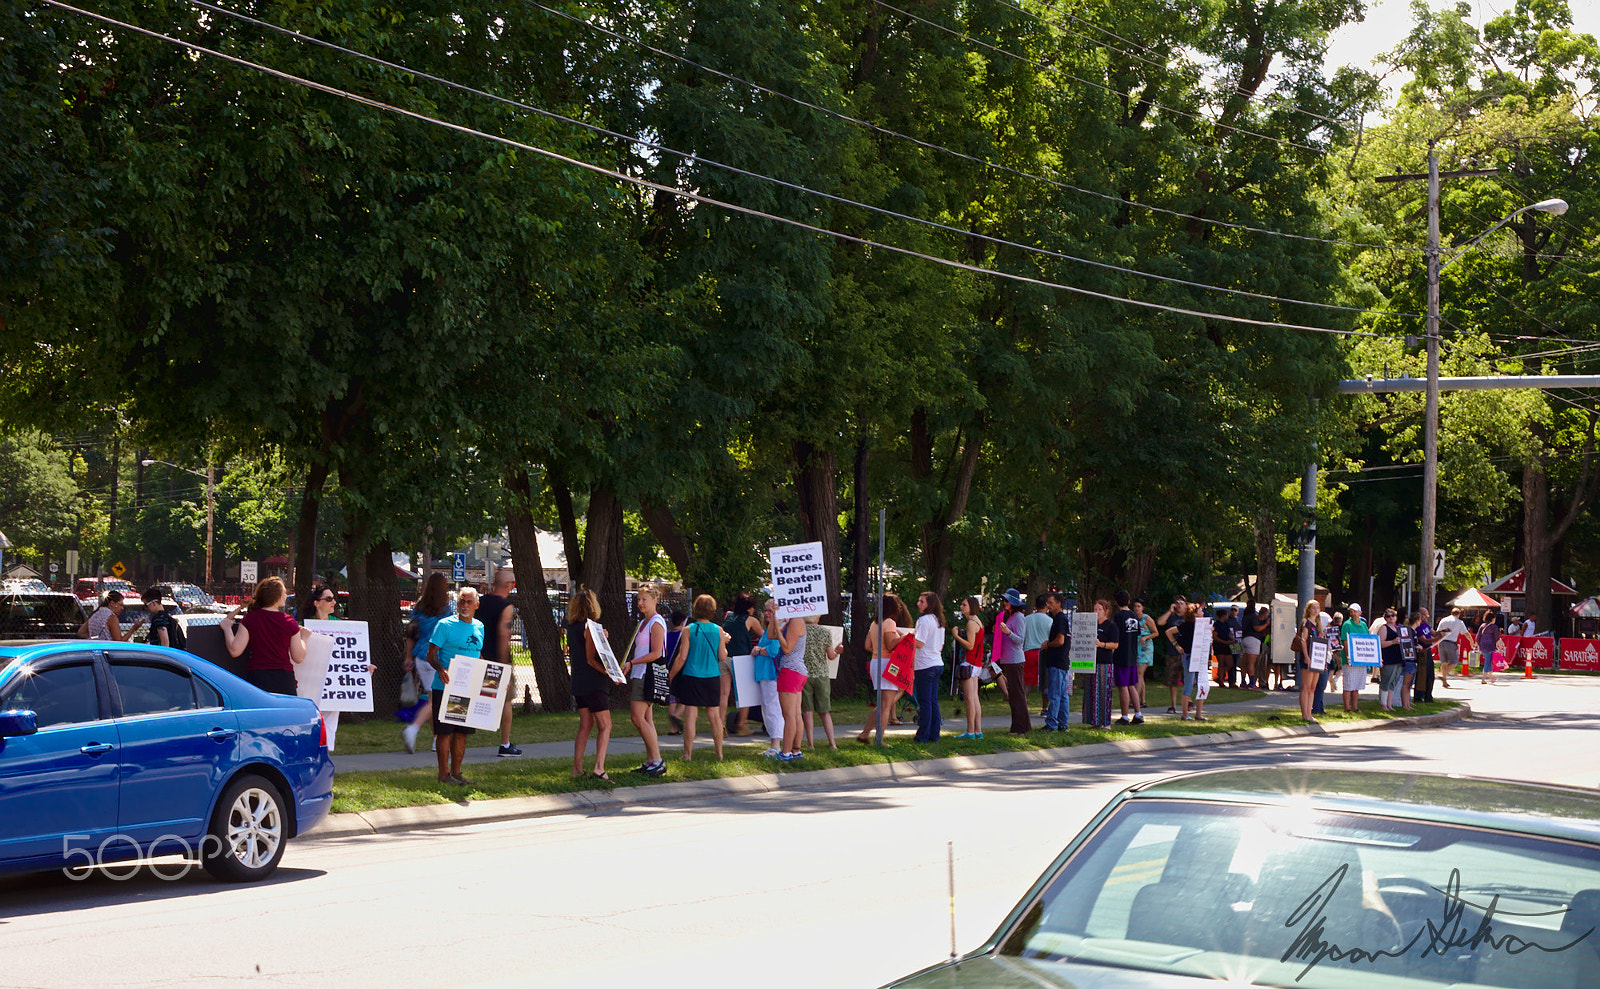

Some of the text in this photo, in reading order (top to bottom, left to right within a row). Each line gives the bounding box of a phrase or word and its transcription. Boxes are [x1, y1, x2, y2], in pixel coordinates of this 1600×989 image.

[782, 554, 812, 563] Race
[774, 564, 822, 575] Horses:
[776, 574, 822, 585] Beaten
[788, 584, 812, 594] and
[778, 595, 824, 606] Broken
[786, 603, 816, 613] DEAD
[334, 636, 357, 648] op
[332, 647, 367, 662] cing
[1564, 650, 1598, 663] SARATOGA
[328, 663, 369, 672] orses
[338, 674, 366, 686] the
